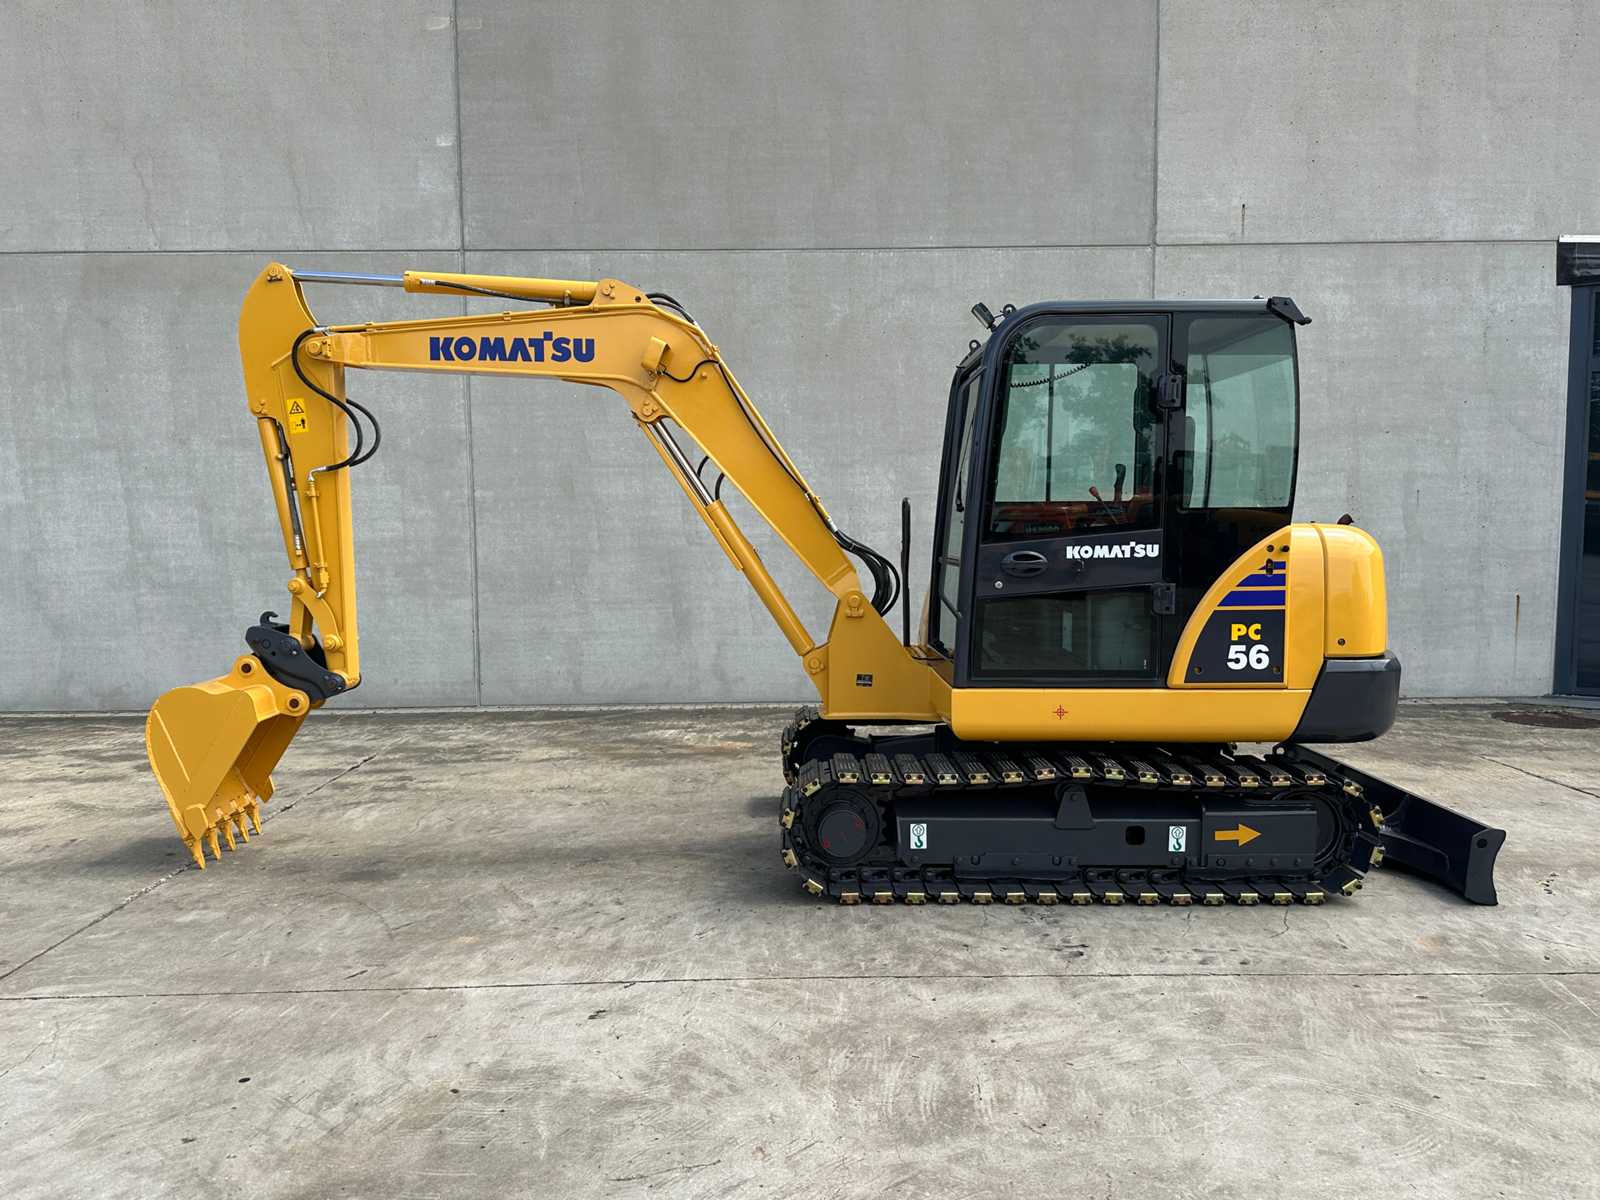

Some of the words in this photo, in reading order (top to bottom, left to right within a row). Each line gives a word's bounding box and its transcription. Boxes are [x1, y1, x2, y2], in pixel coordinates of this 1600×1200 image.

[429, 331, 595, 362] KOMATSU
[1066, 541, 1159, 559] KOMATSU
[1231, 623, 1262, 641] PC
[1226, 644, 1270, 670] 56
